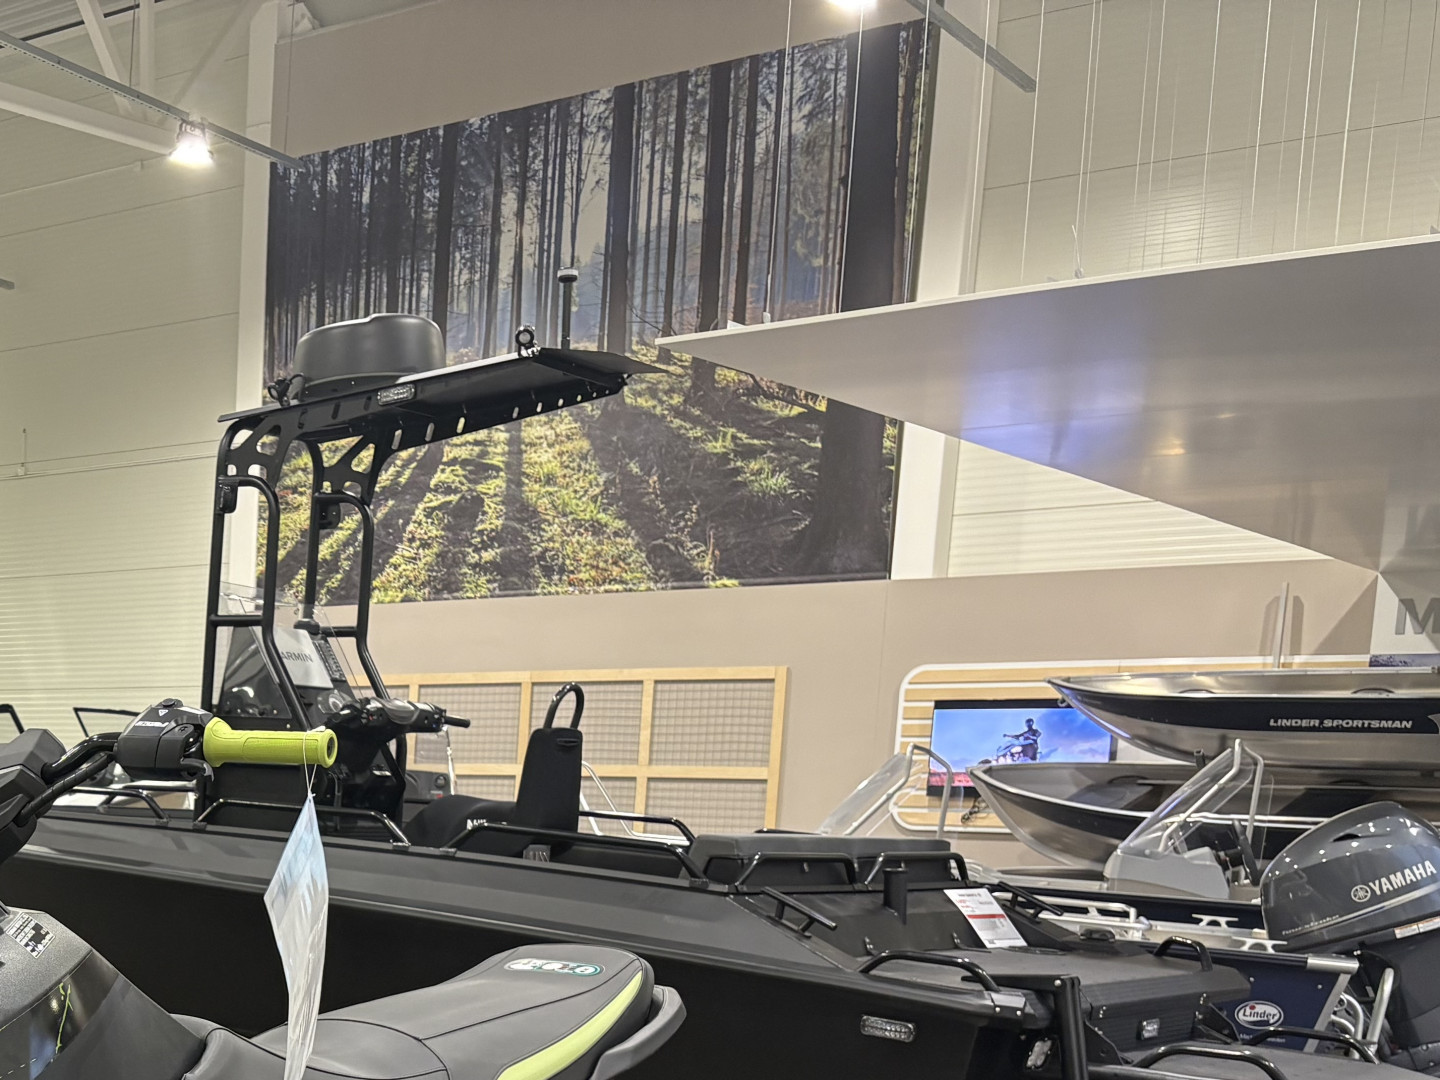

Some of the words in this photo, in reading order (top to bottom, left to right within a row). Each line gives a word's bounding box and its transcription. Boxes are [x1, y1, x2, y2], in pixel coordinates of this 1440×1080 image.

[280, 651, 314, 663] ARMIN
[1269, 718, 1320, 728] LINDER
[1322, 718, 1413, 729] SPORTSMAN
[1368, 860, 1437, 896] YAMAHA
[1242, 1004, 1278, 1021] Linder
